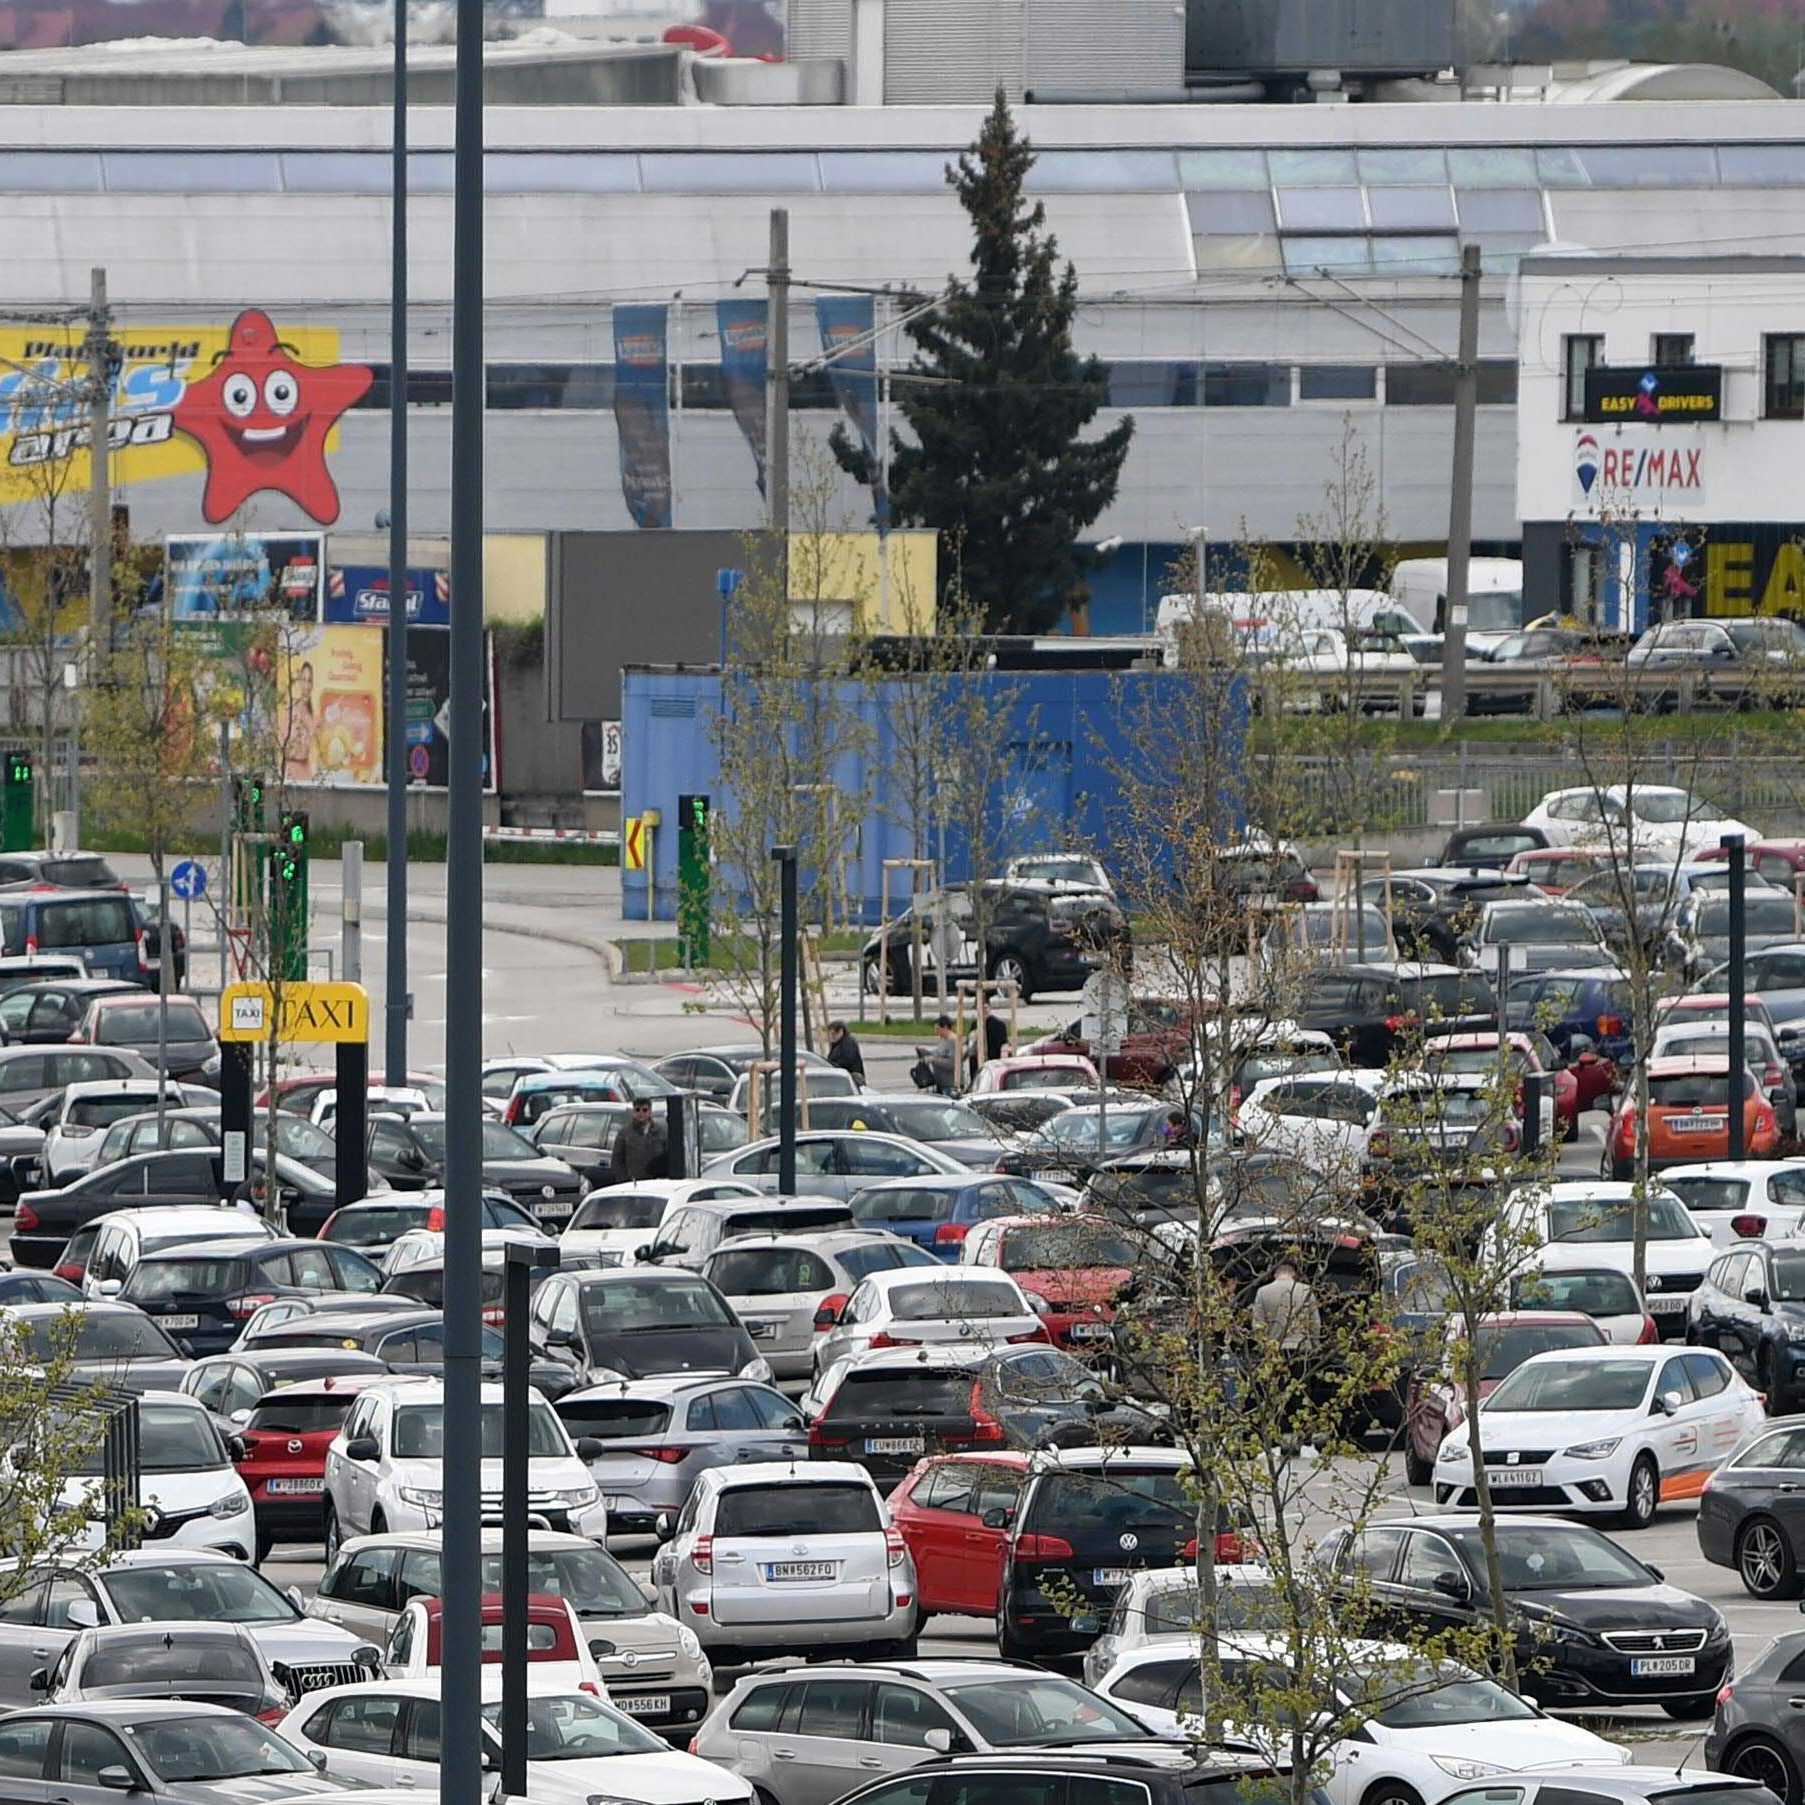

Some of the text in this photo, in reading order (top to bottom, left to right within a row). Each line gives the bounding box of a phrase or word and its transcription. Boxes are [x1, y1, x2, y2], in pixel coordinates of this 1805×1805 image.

[1601, 394, 1714, 410] EASY DRIVERS
[1603, 448, 1703, 489] RE/MAX
[235, 1007, 261, 1019] TAXI
[279, 1000, 353, 1029] TAXI
[776, 1564, 792, 1577] BN
[1641, 1660, 1654, 1672] PL
